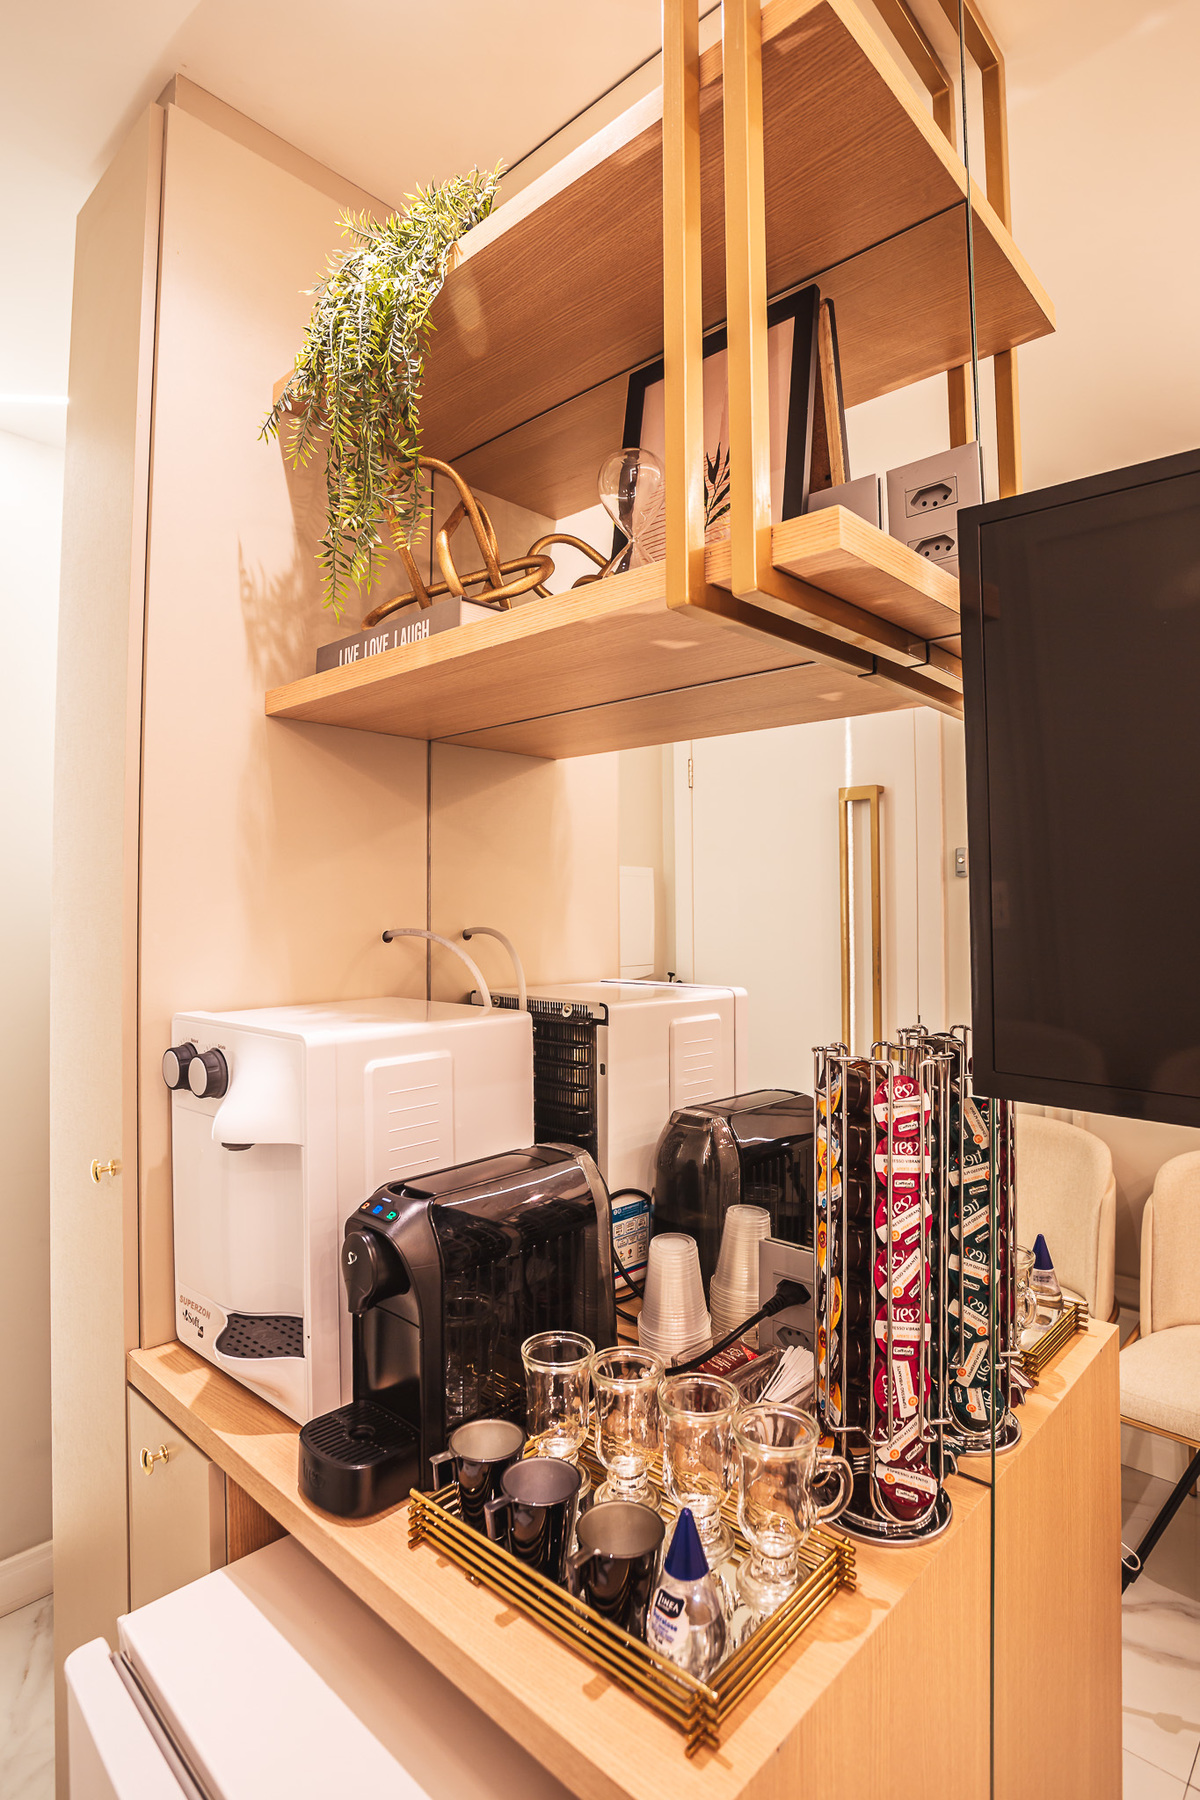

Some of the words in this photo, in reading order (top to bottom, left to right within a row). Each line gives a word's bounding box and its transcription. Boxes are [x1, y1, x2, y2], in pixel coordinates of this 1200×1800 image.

[339, 644, 359, 666] LIVE
[364, 633, 389, 658] LOVE
[395, 619, 430, 648] LAUGH
[883, 1083, 914, 1100] tes
[892, 1142, 919, 1155] res
[878, 1250, 908, 1276] tes
[179, 1295, 211, 1319] SUPERZON
[878, 1418, 908, 1439] tes
[657, 1592, 679, 1614] LINEA
